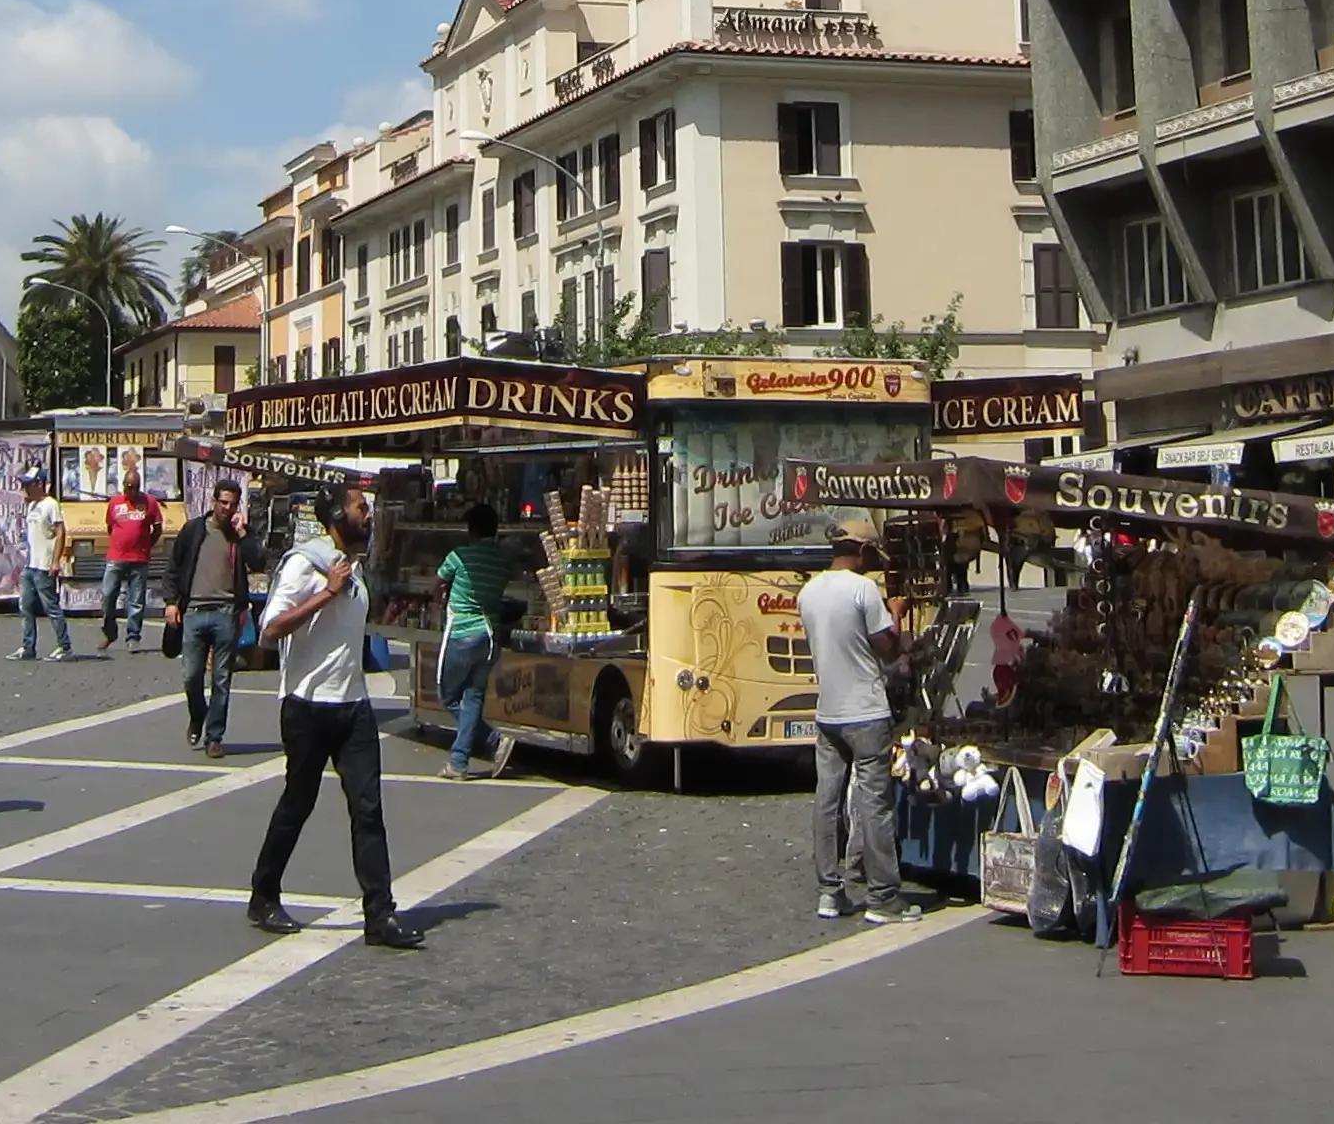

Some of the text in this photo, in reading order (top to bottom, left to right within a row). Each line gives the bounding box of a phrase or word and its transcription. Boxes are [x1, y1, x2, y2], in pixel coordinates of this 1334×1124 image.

[746, 365, 876, 395] Gelateria 900
[260, 395, 306, 429] BIBITE
[311, 390, 365, 426] GELATI
[370, 385, 397, 420] ICE
[399, 376, 458, 416] CREAM
[464, 376, 635, 424] DRINKS
[933, 392, 1082, 430] ICE CREAM
[66, 431, 140, 445] IMPERIAL
[223, 449, 348, 484] Souvenirs
[815, 465, 932, 501] Souvenirs
[713, 501, 755, 532] Ice
[1055, 471, 1289, 529] Souvenirs
[757, 592, 799, 615] Gelat
